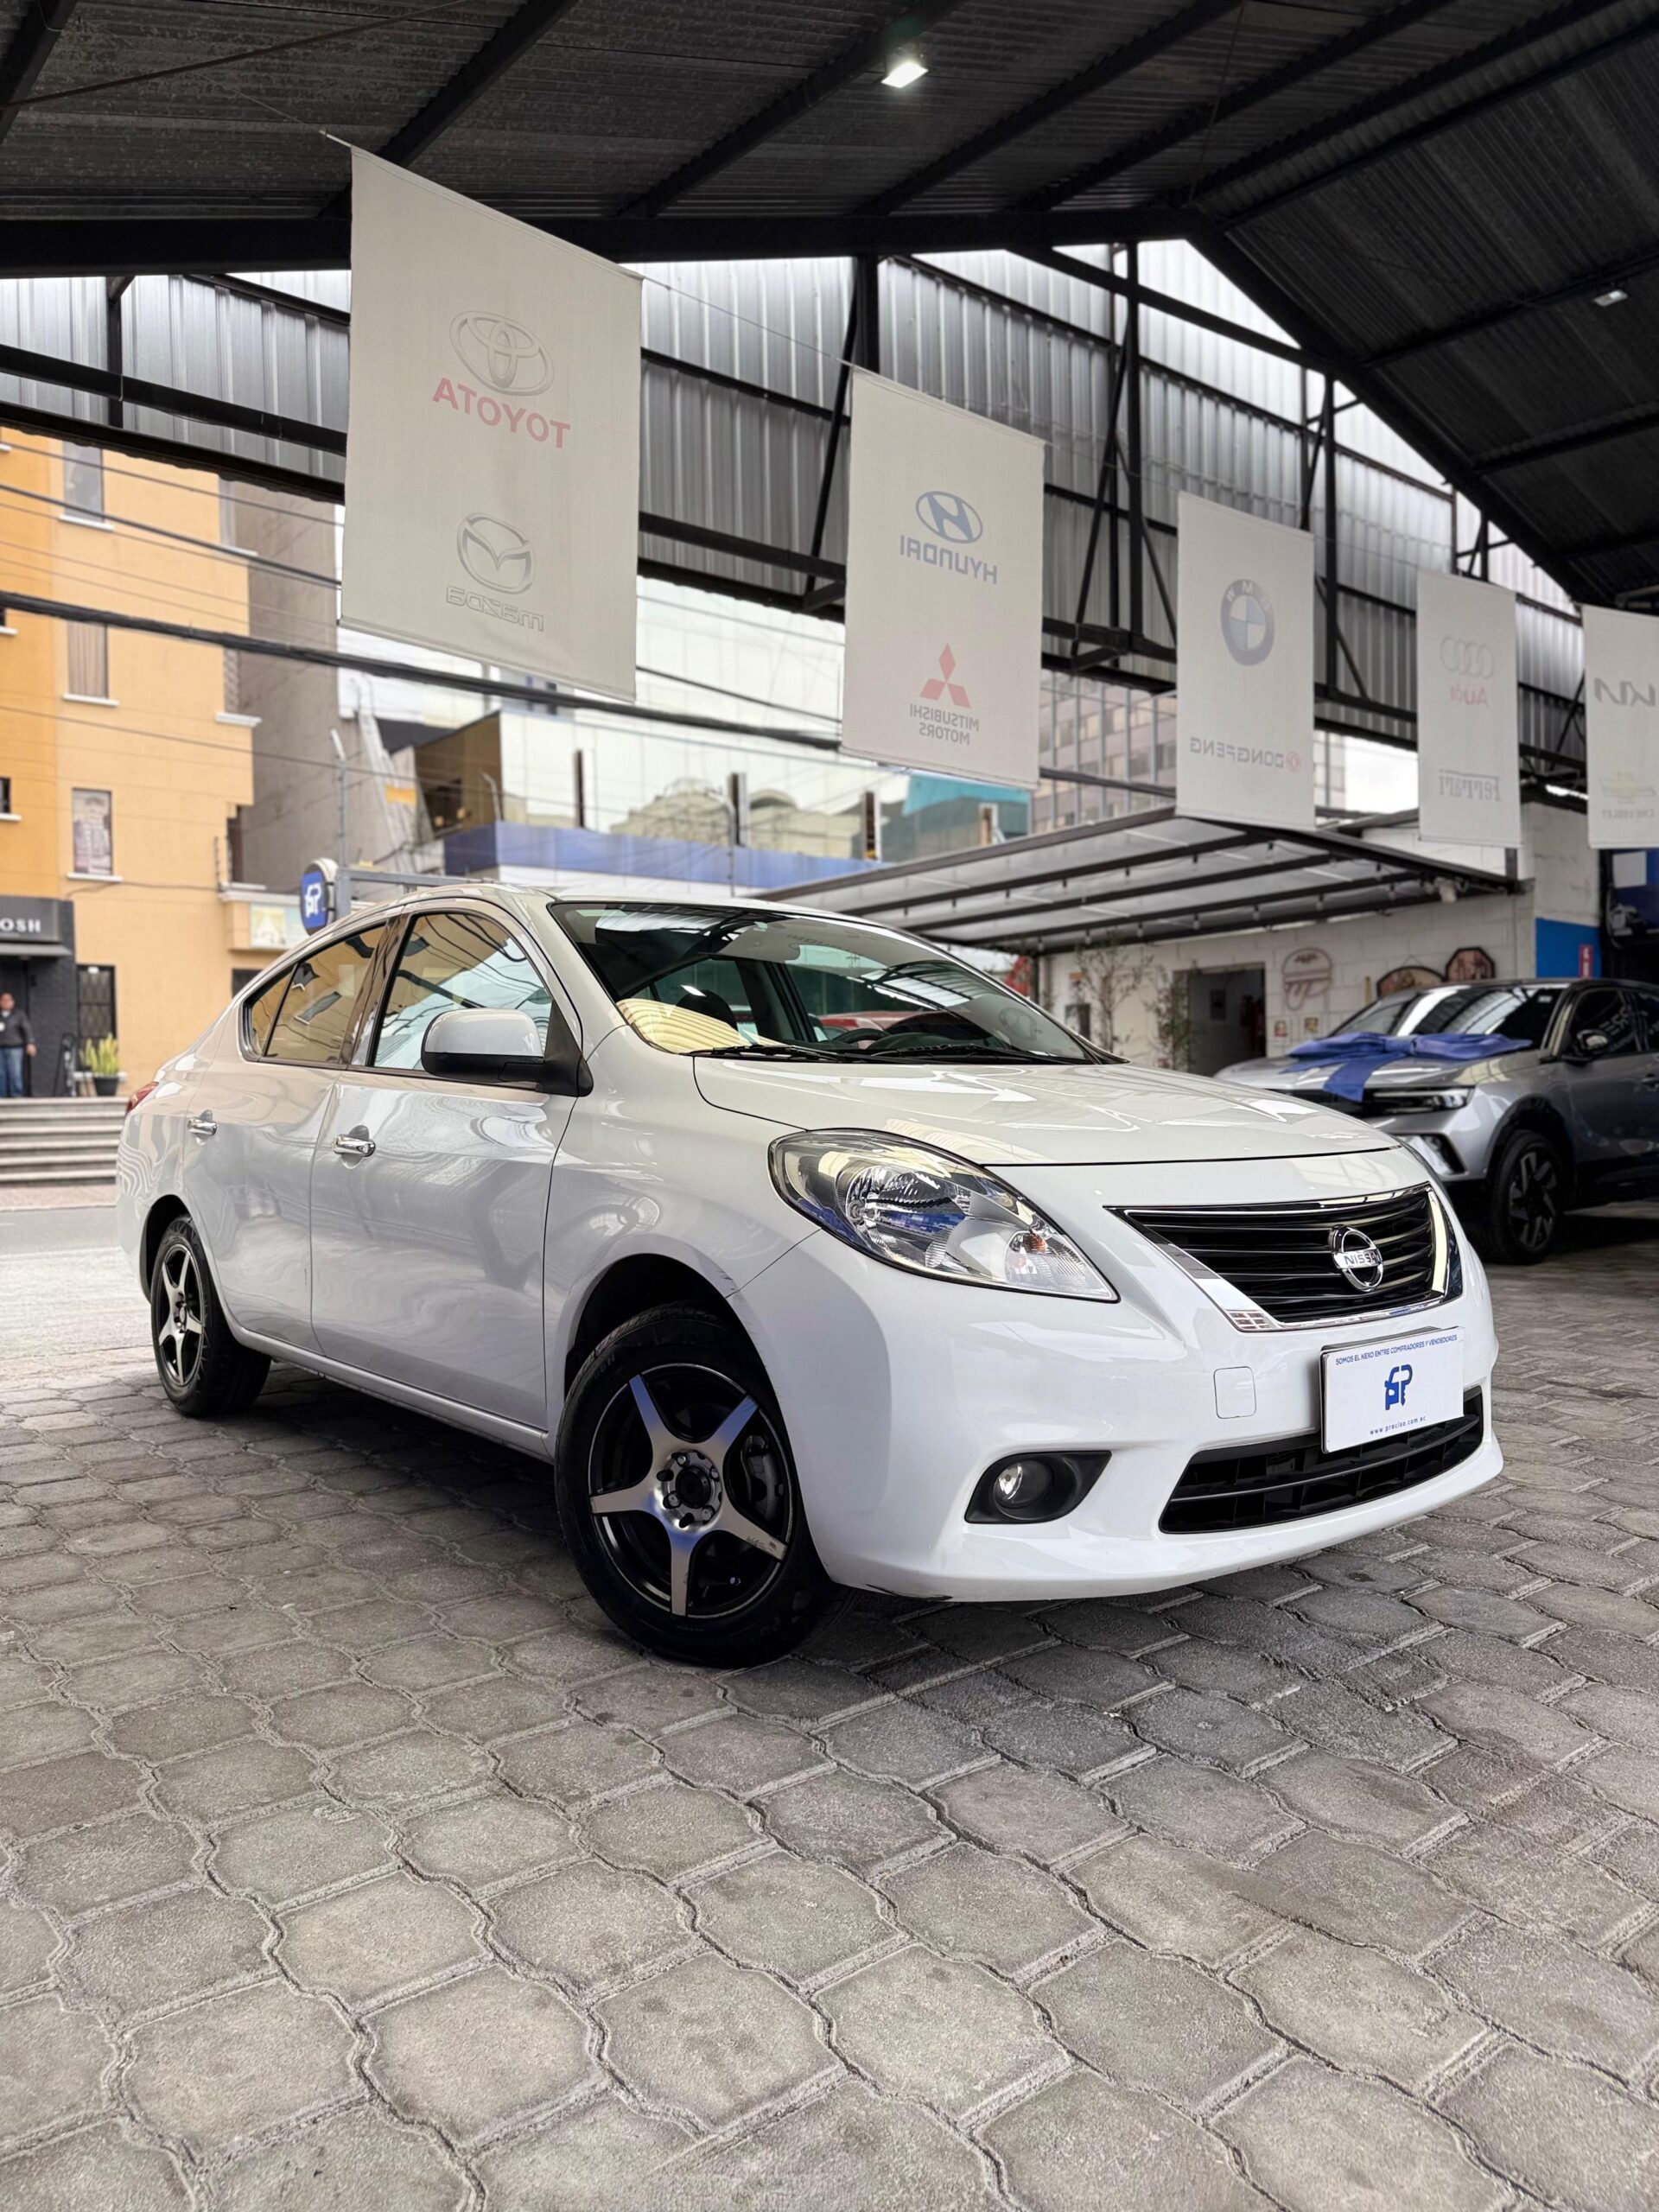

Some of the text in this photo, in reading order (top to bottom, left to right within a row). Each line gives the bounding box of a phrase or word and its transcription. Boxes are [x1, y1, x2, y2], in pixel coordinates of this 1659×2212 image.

[1336, 1356, 1354, 1365] SOMOS
[1361, 1351, 1374, 1359] NEXO
[1375, 1348, 1390, 1357] ENTRE
[1390, 1341, 1425, 1354] COMPRADORES
[1428, 1334, 1458, 1345] VENDEDORES
